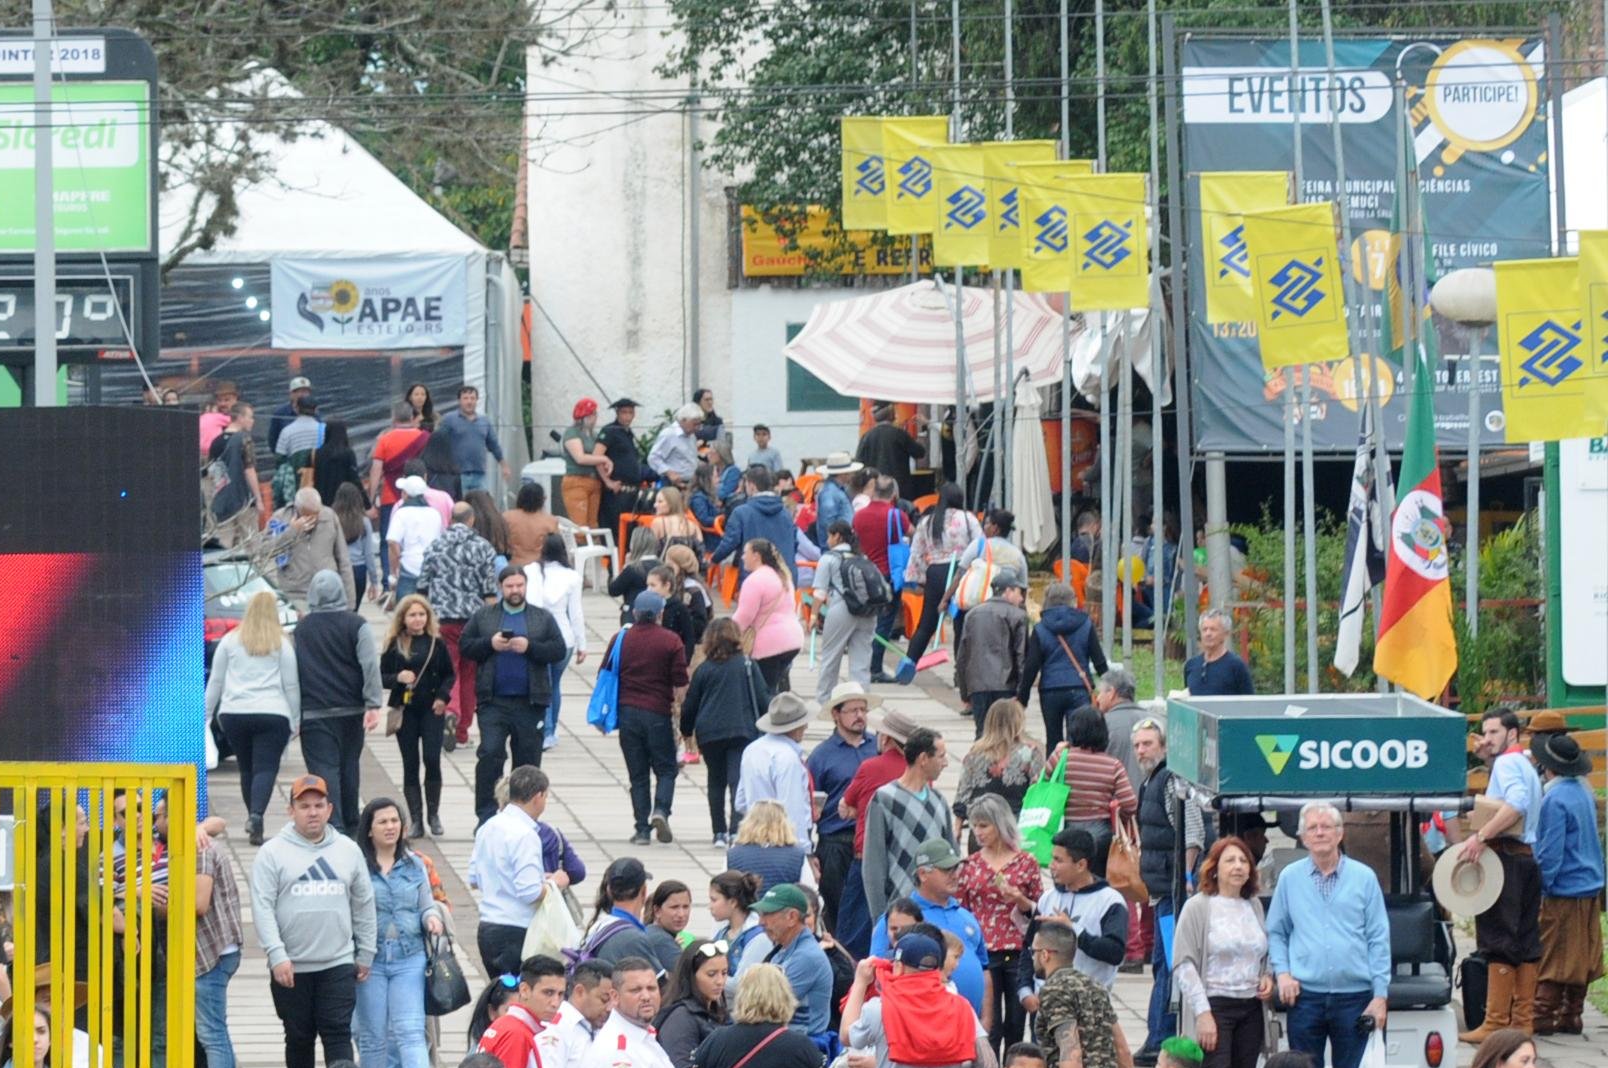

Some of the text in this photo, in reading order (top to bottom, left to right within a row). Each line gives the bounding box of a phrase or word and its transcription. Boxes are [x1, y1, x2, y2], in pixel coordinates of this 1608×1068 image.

[60, 48, 102, 61] 2018
[1227, 76, 1367, 115] EVENTOS
[1442, 84, 1520, 103] PARTICIPE!
[1460, 241, 1498, 257] CÍVICO
[364, 287, 391, 296] anos
[358, 296, 443, 323] APAE
[1298, 739, 1429, 770] SICOOB
[291, 880, 346, 897] adidas
